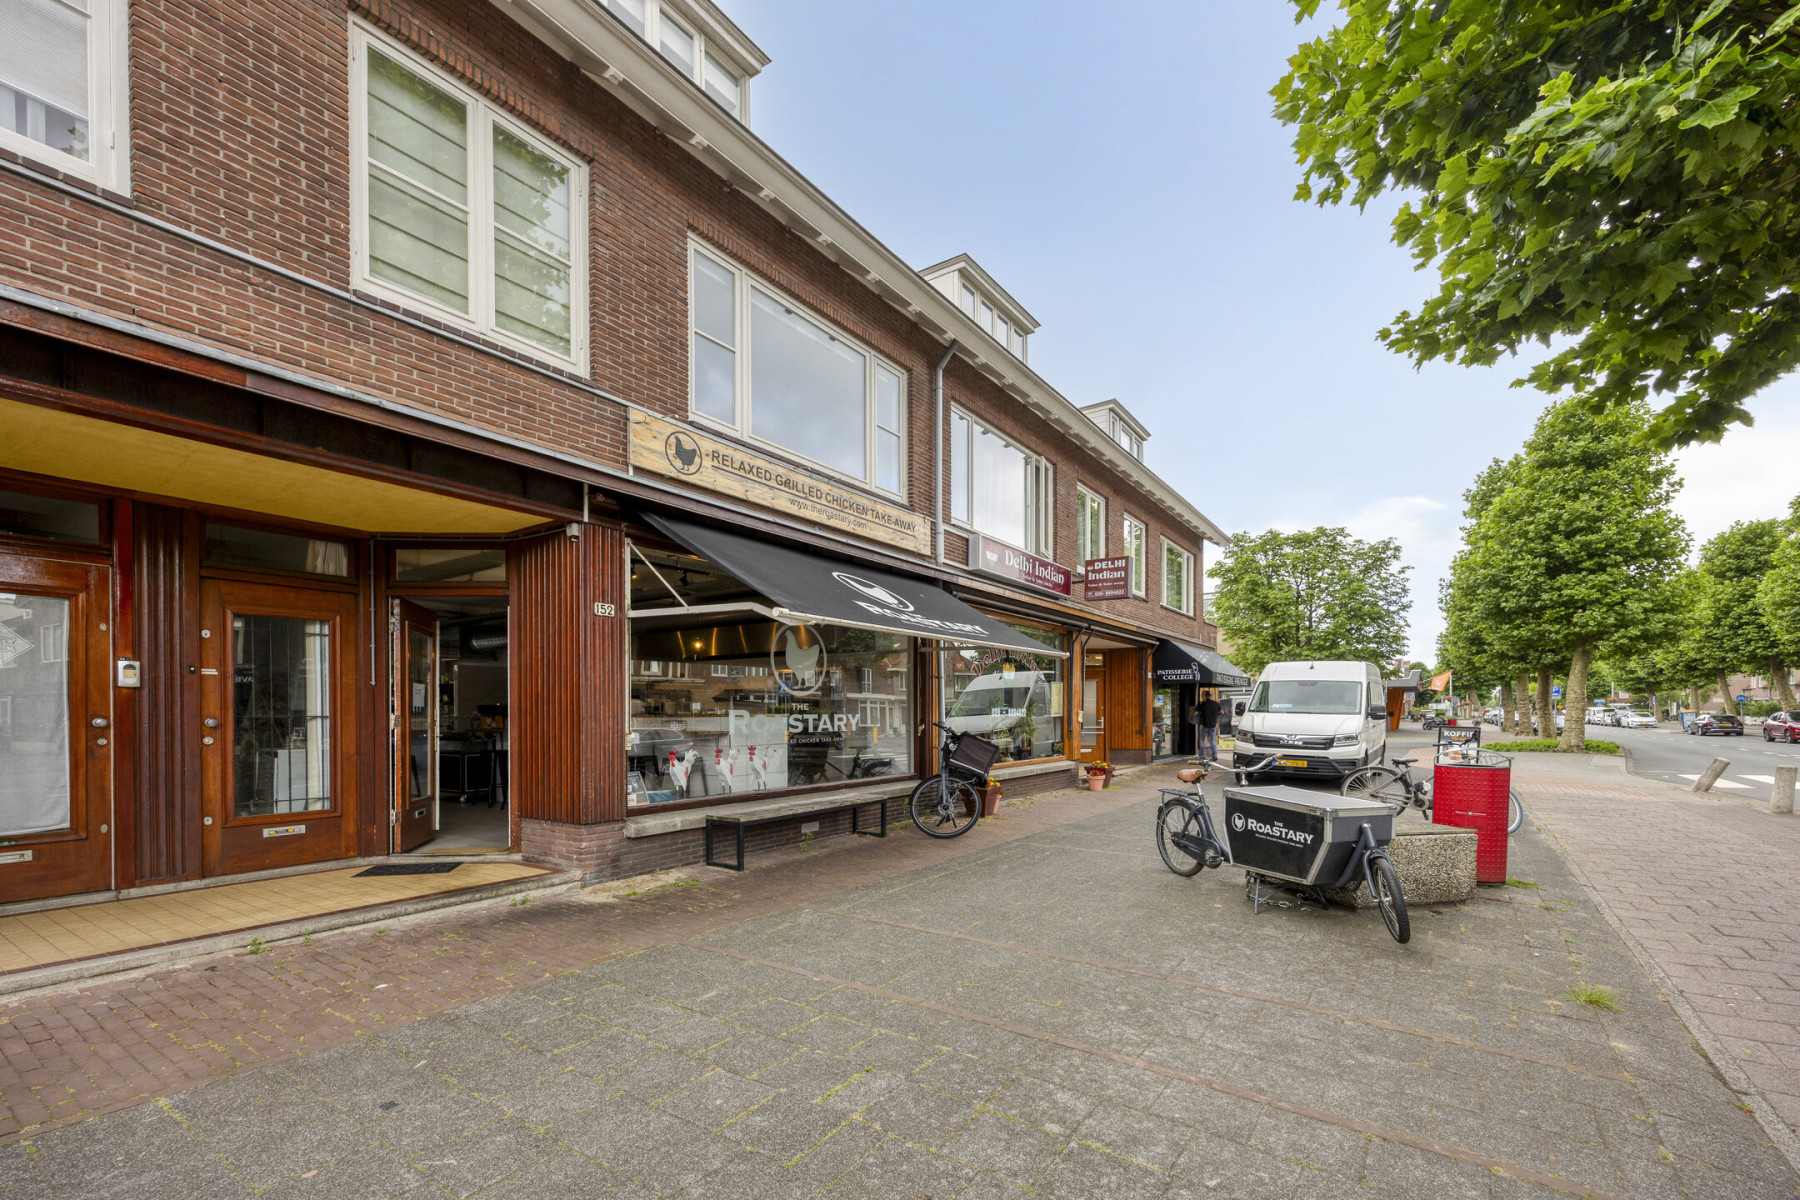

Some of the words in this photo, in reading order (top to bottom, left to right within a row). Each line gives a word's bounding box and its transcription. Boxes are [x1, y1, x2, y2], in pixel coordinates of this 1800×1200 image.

[711, 449, 772, 482] RELAXED
[775, 473, 823, 500] GRILLED
[825, 492, 868, 516] CHICKEN
[869, 508, 916, 533] TAKE-AWAY
[789, 498, 867, 530] www.theroastary.com
[1004, 549, 1033, 574] Delhi
[1035, 560, 1065, 585] Indian
[1094, 559, 1126, 570] DELHI
[1088, 570, 1125, 580] Indian
[596, 603, 613, 615] 152
[791, 702, 809, 711] THE
[1247, 817, 1314, 845] ROASTARY
